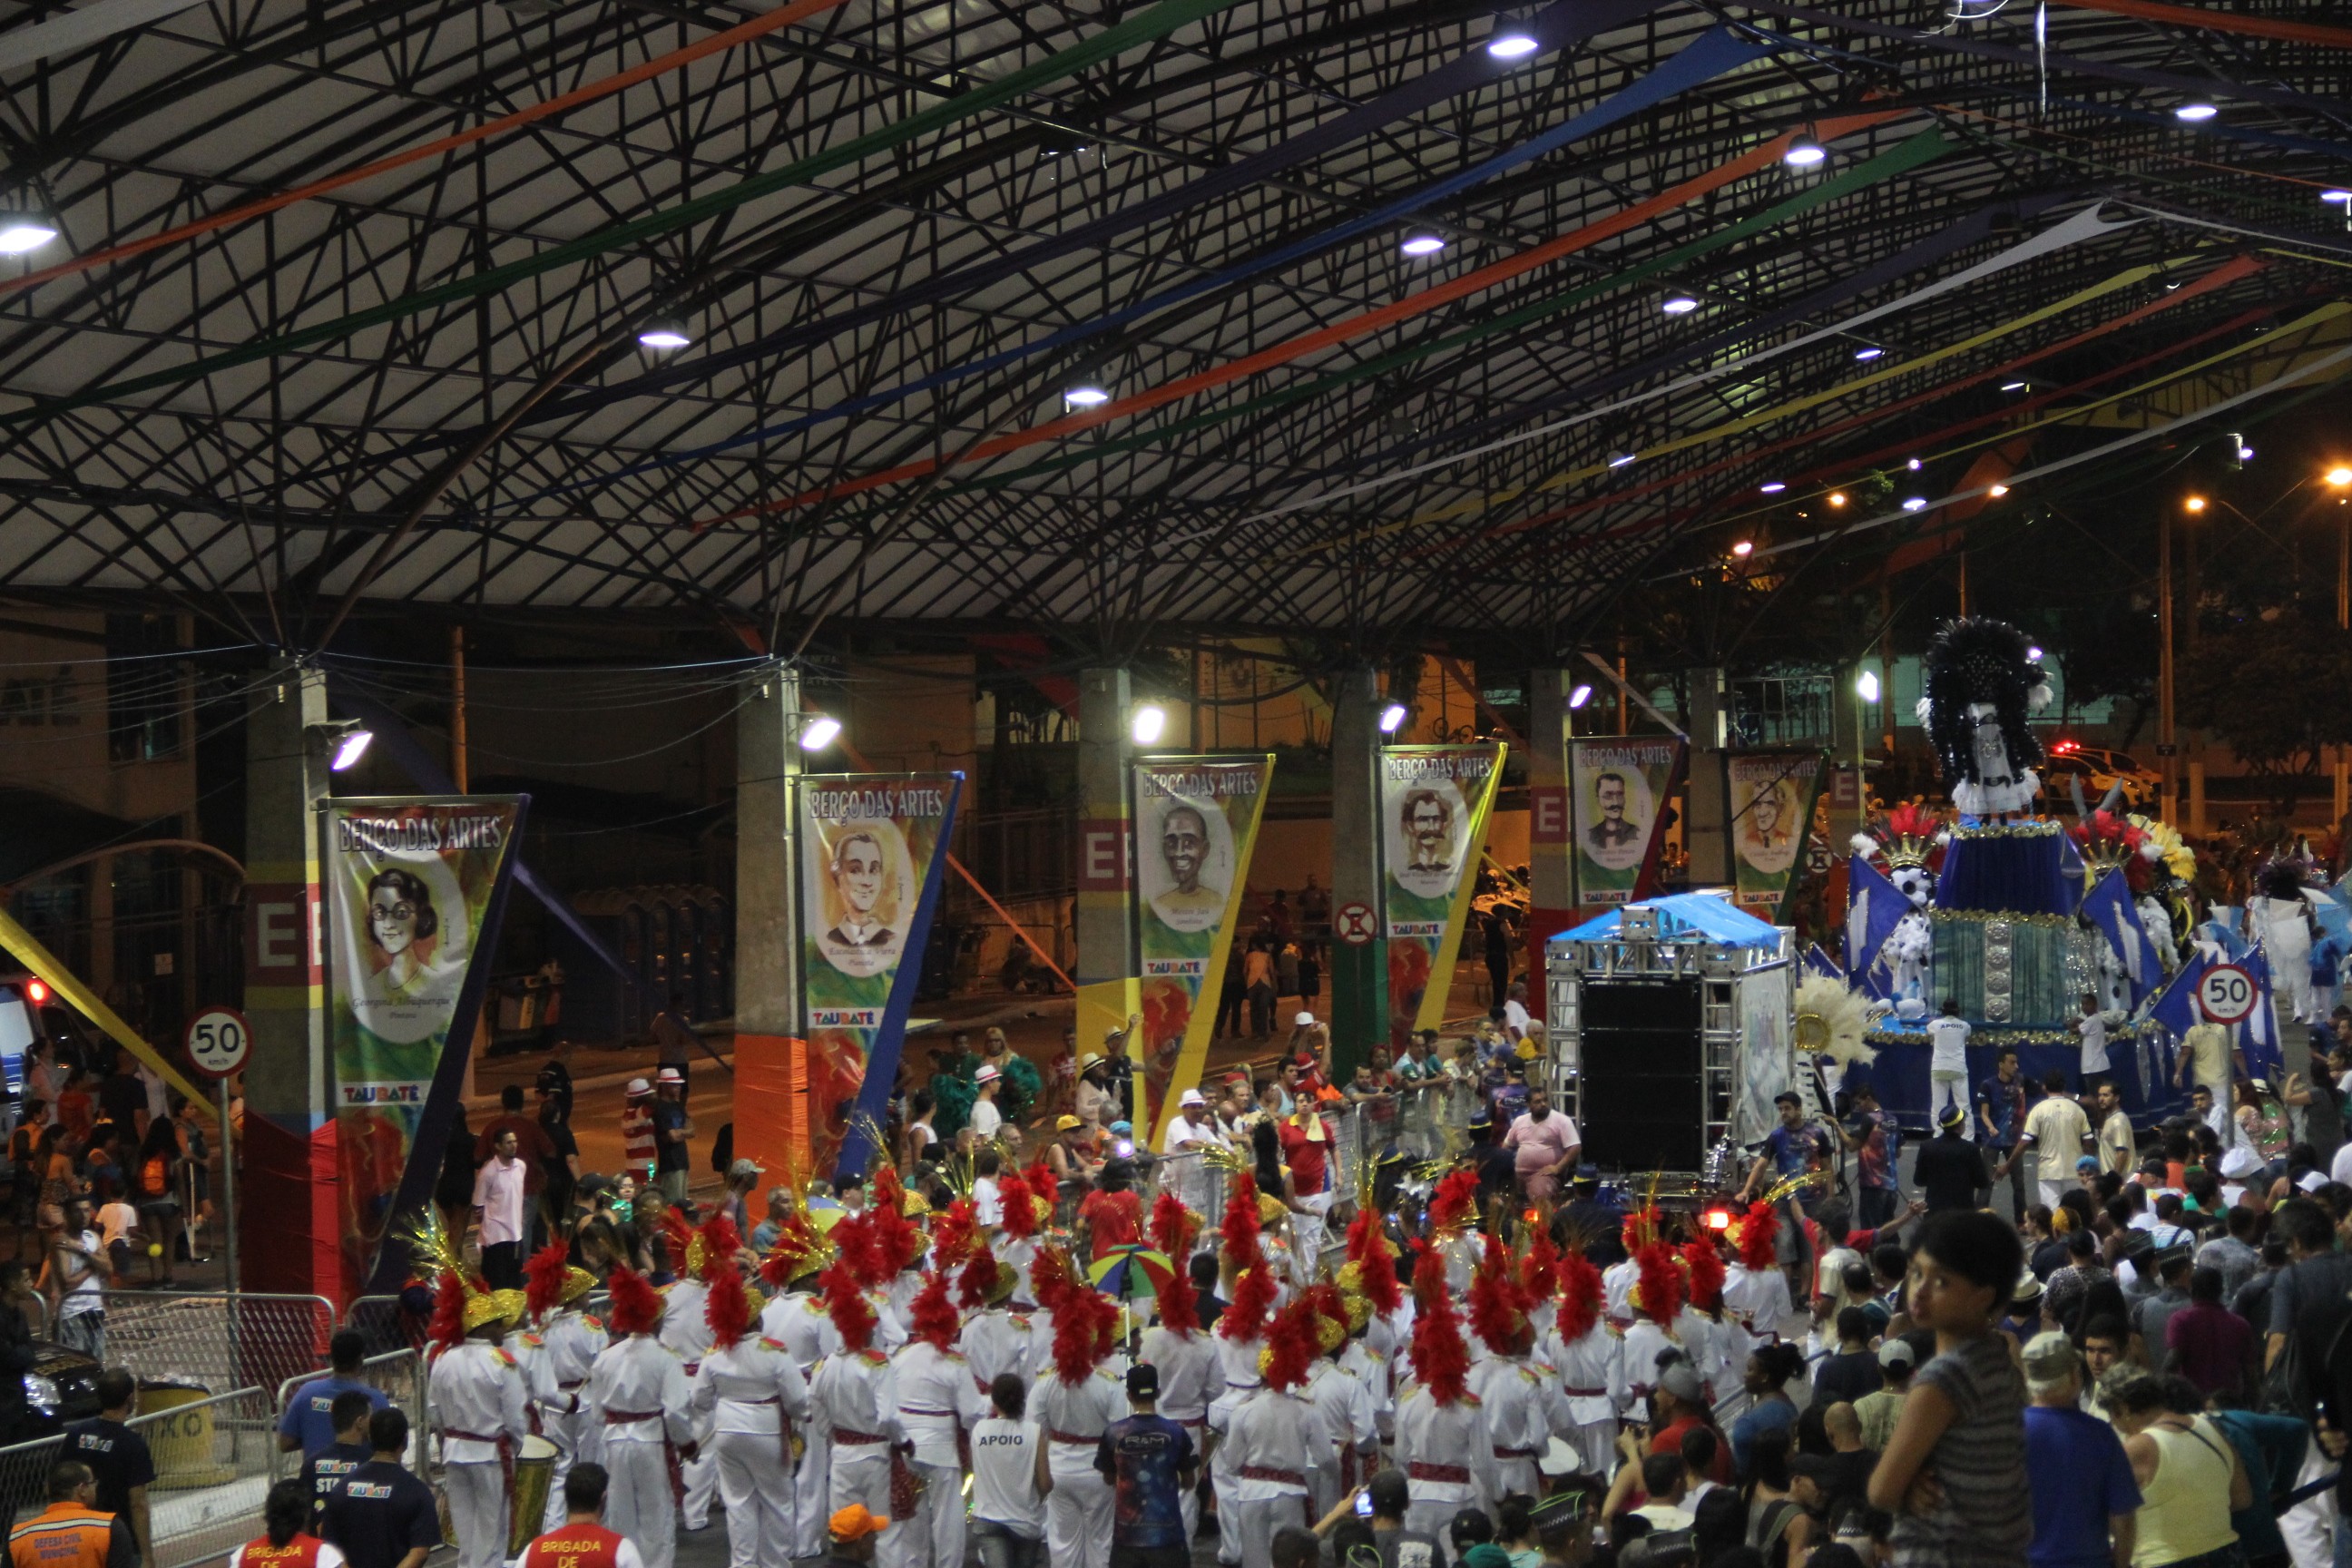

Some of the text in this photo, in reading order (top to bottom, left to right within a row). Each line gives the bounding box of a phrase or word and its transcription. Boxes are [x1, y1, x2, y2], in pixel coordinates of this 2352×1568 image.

[1581, 746, 1671, 771] BERÇO DAS ARTES
[1389, 757, 1491, 786] BERÇO DAS ARTES
[1144, 771, 1257, 804] BERÇO DAS ARTES
[1835, 772, 1854, 800] E
[810, 789, 944, 827] BERÇO DAS ARTES
[1539, 797, 1561, 832] E
[338, 815, 502, 861] BERÇO DAS ARTES
[1086, 832, 1114, 878] E
[258, 902, 298, 966] E
[1392, 924, 1438, 935] TAUBATÉ
[1148, 961, 1200, 974] TAUBATÉ
[2210, 978, 2247, 1004] 50
[813, 1010, 875, 1026] TAUBATÉ
[196, 1023, 240, 1054] 50
[208, 1057, 230, 1066] km/h
[343, 1084, 419, 1102] TAUBATÉ
[979, 1435, 1024, 1446] APOIO
[348, 1485, 392, 1498] TAUBATÉ
[34, 1536, 63, 1549] DEFESA
[541, 1540, 602, 1553] BRIGADA
[557, 1556, 580, 1568] DE
